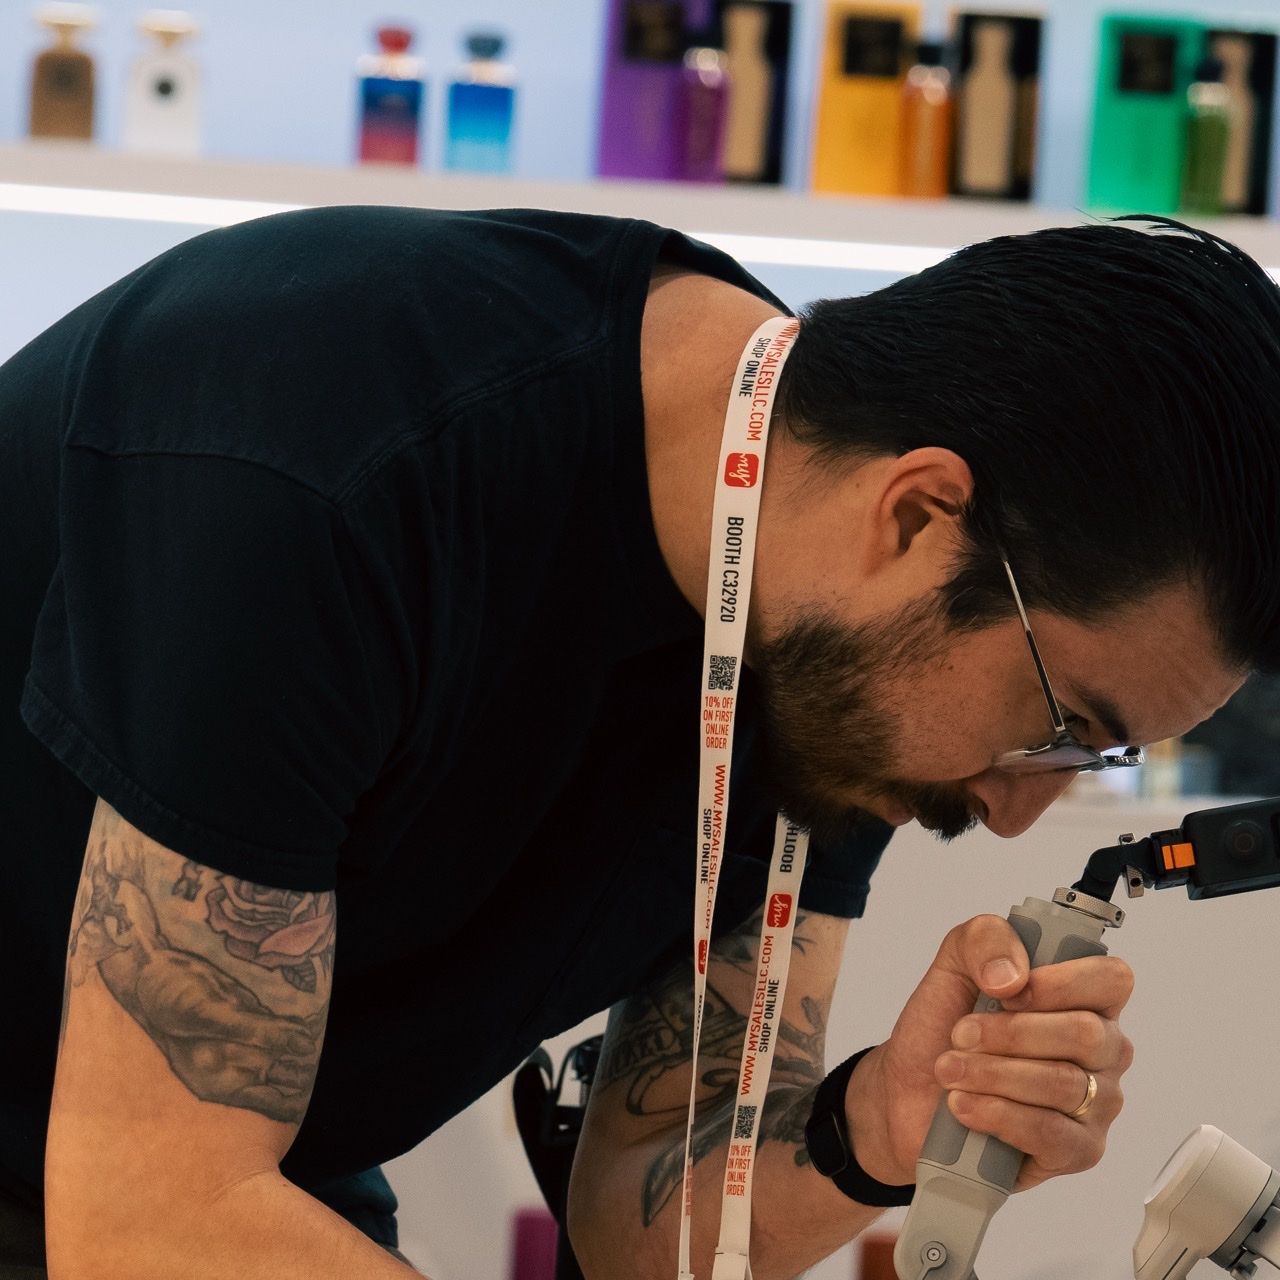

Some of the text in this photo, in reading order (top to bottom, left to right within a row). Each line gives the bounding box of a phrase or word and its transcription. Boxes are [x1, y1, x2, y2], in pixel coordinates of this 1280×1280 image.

[738, 337, 772, 398] SHOP ONLINE
[720, 516, 745, 623] BOOTH C32920
[705, 695, 734, 709] 10% OFF
[703, 709, 733, 722] ON FIRST
[706, 723, 730, 736] ONLINE
[706, 736, 728, 750] ORDER
[700, 808, 712, 885] SHOP ONLINE
[705, 764, 726, 929] WWW.MYSALESLLC.COM
[780, 826, 799, 873] BOOTH
[740, 935, 775, 1096] WWW.MYSALESLLC.COM
[759, 978, 780, 1053] SHOP ONLINE
[740, 1145, 752, 1157] OFF
[734, 1158, 751, 1170] FIRST
[727, 1171, 747, 1183] ONLINE
[726, 1184, 745, 1197] ORDER
